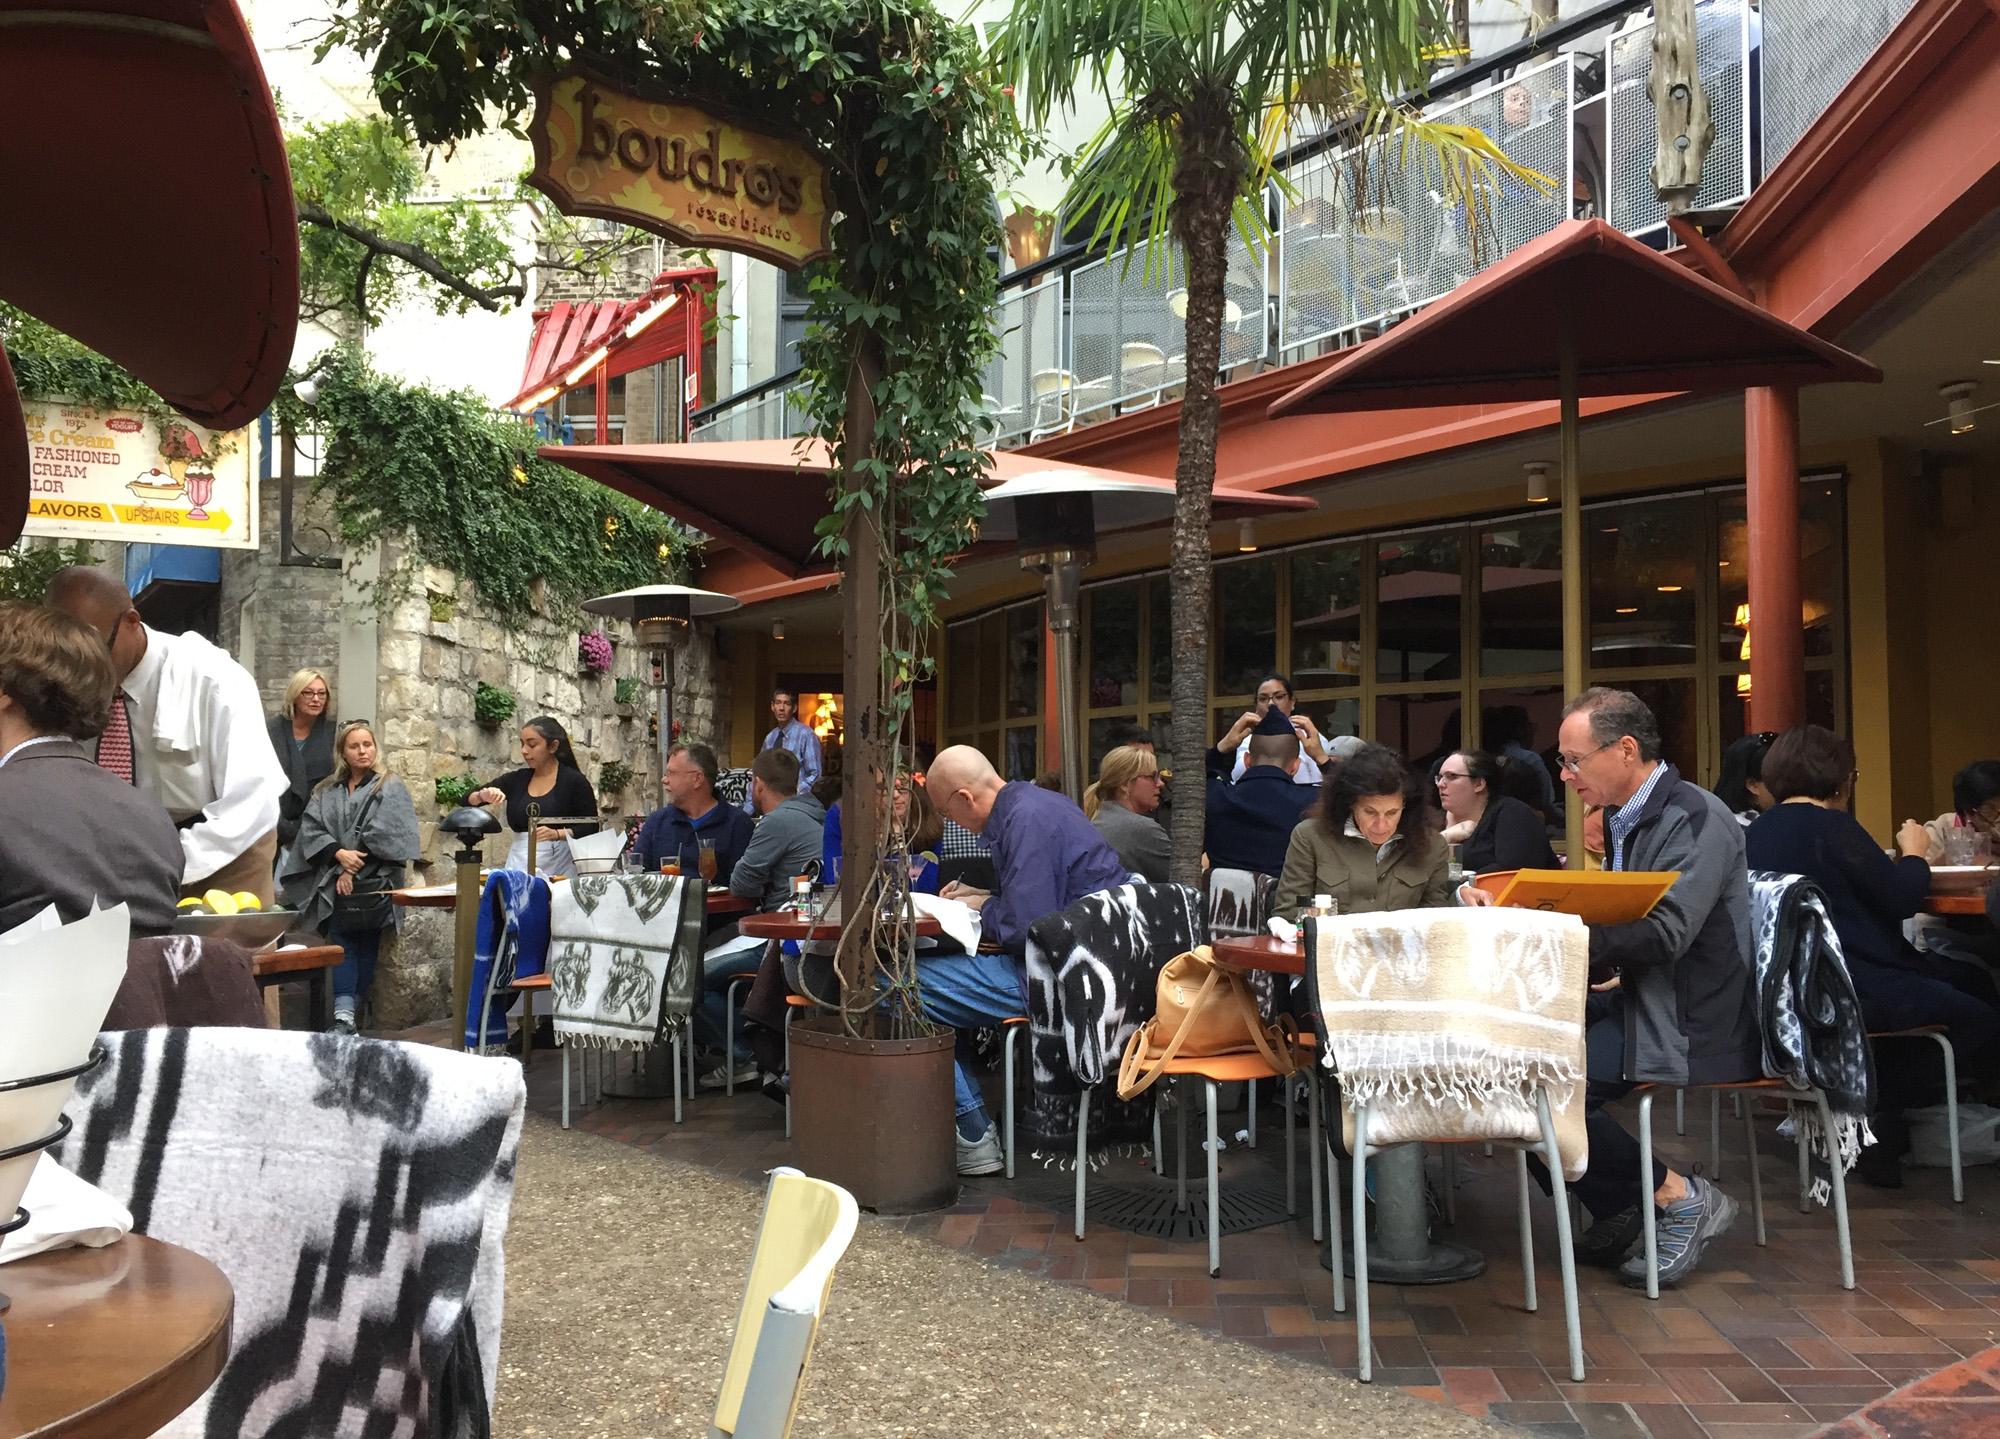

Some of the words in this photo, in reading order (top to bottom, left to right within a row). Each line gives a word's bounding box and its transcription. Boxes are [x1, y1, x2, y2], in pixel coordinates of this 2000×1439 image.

[741, 208, 792, 242] bistro
[49, 429, 114, 448] Cream
[34, 446, 121, 465] FASHIONED
[32, 463, 87, 478] CREAM
[29, 478, 64, 493] LOR
[29, 503, 101, 519] LAVORS
[126, 508, 180, 524] UPSTAIRS
